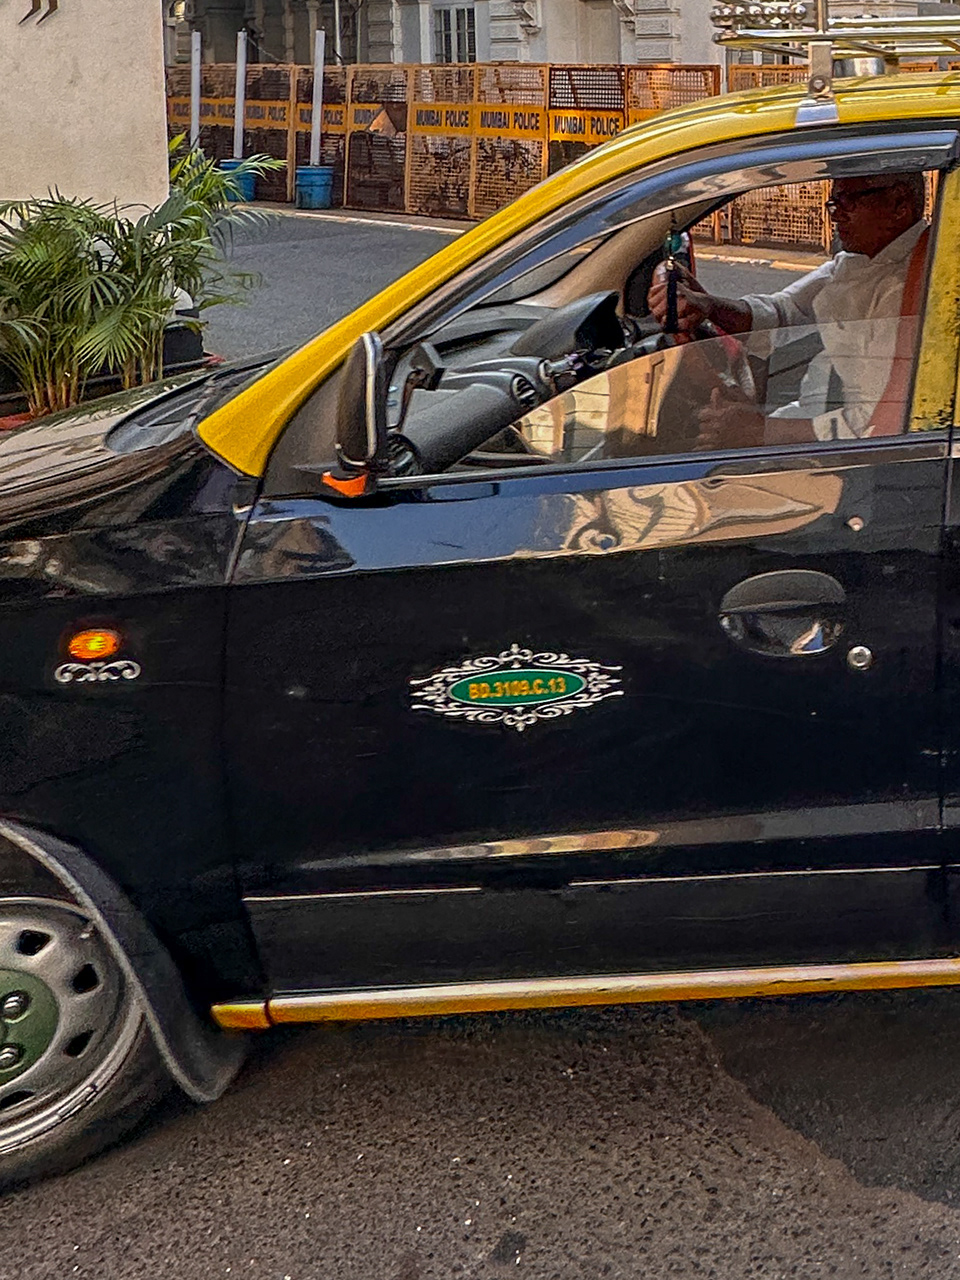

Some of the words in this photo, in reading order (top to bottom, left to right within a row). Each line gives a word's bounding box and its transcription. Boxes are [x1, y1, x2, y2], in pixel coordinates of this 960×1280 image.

[416, 109, 443, 127] MUMBAI
[445, 110, 469, 128] POLICE
[480, 111, 510, 130] MUMBAI
[513, 112, 540, 131] POLICE
[554, 115, 586, 135] MUMBAI
[590, 117, 620, 136] POLICE
